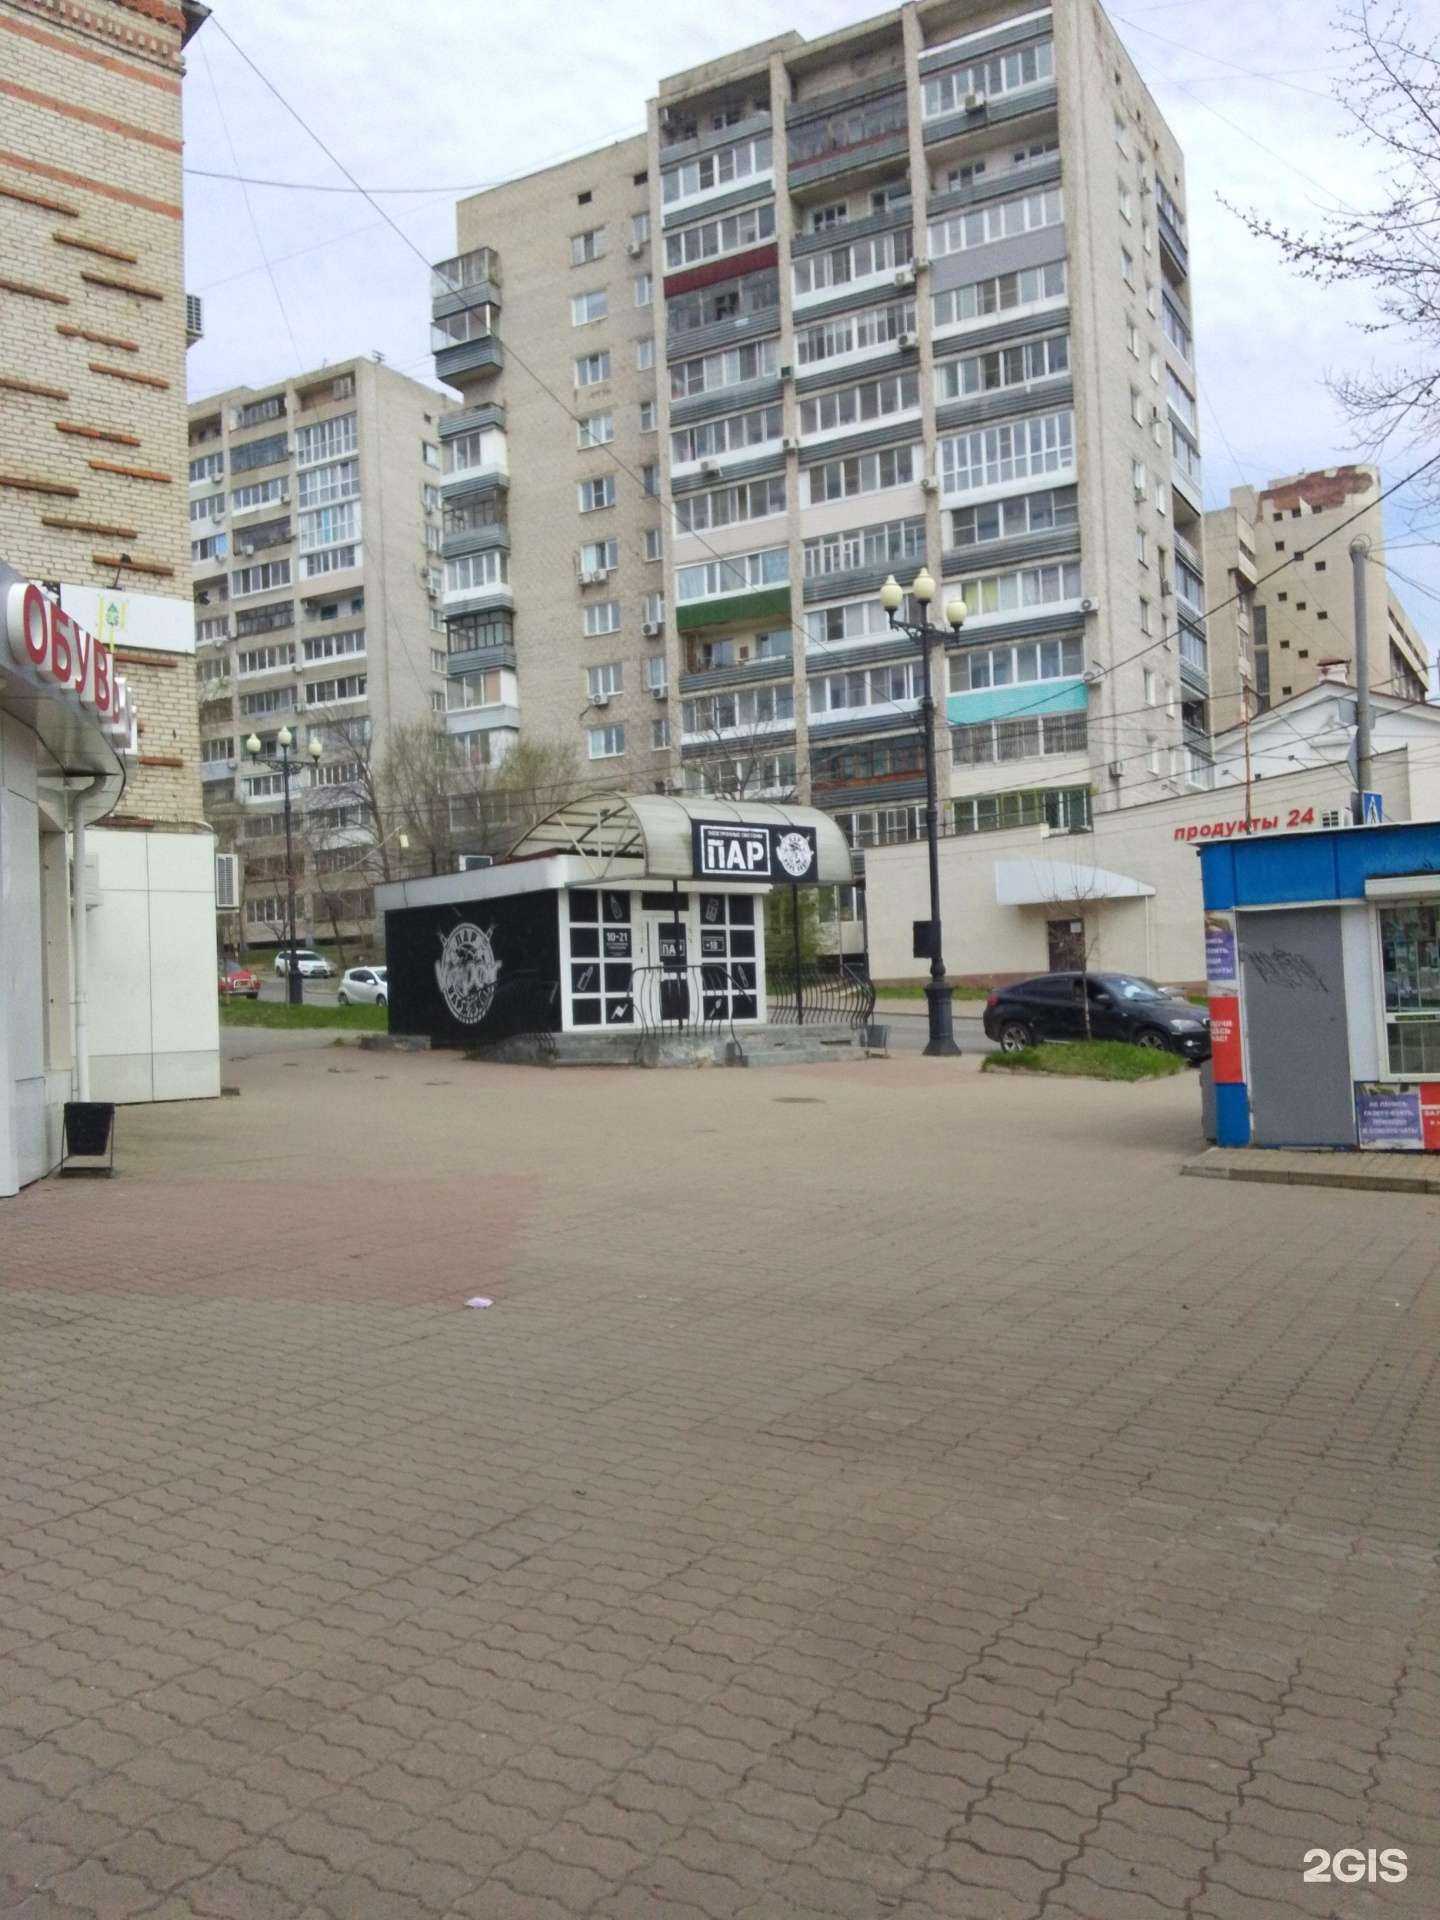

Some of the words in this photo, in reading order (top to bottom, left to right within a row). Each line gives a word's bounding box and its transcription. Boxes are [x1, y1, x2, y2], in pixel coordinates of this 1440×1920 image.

[23, 584, 120, 724] ОБУВЬ
[1174, 816, 1278, 841] продукты
[1287, 807, 1315, 827] 24
[707, 839, 764, 870] ПАР
